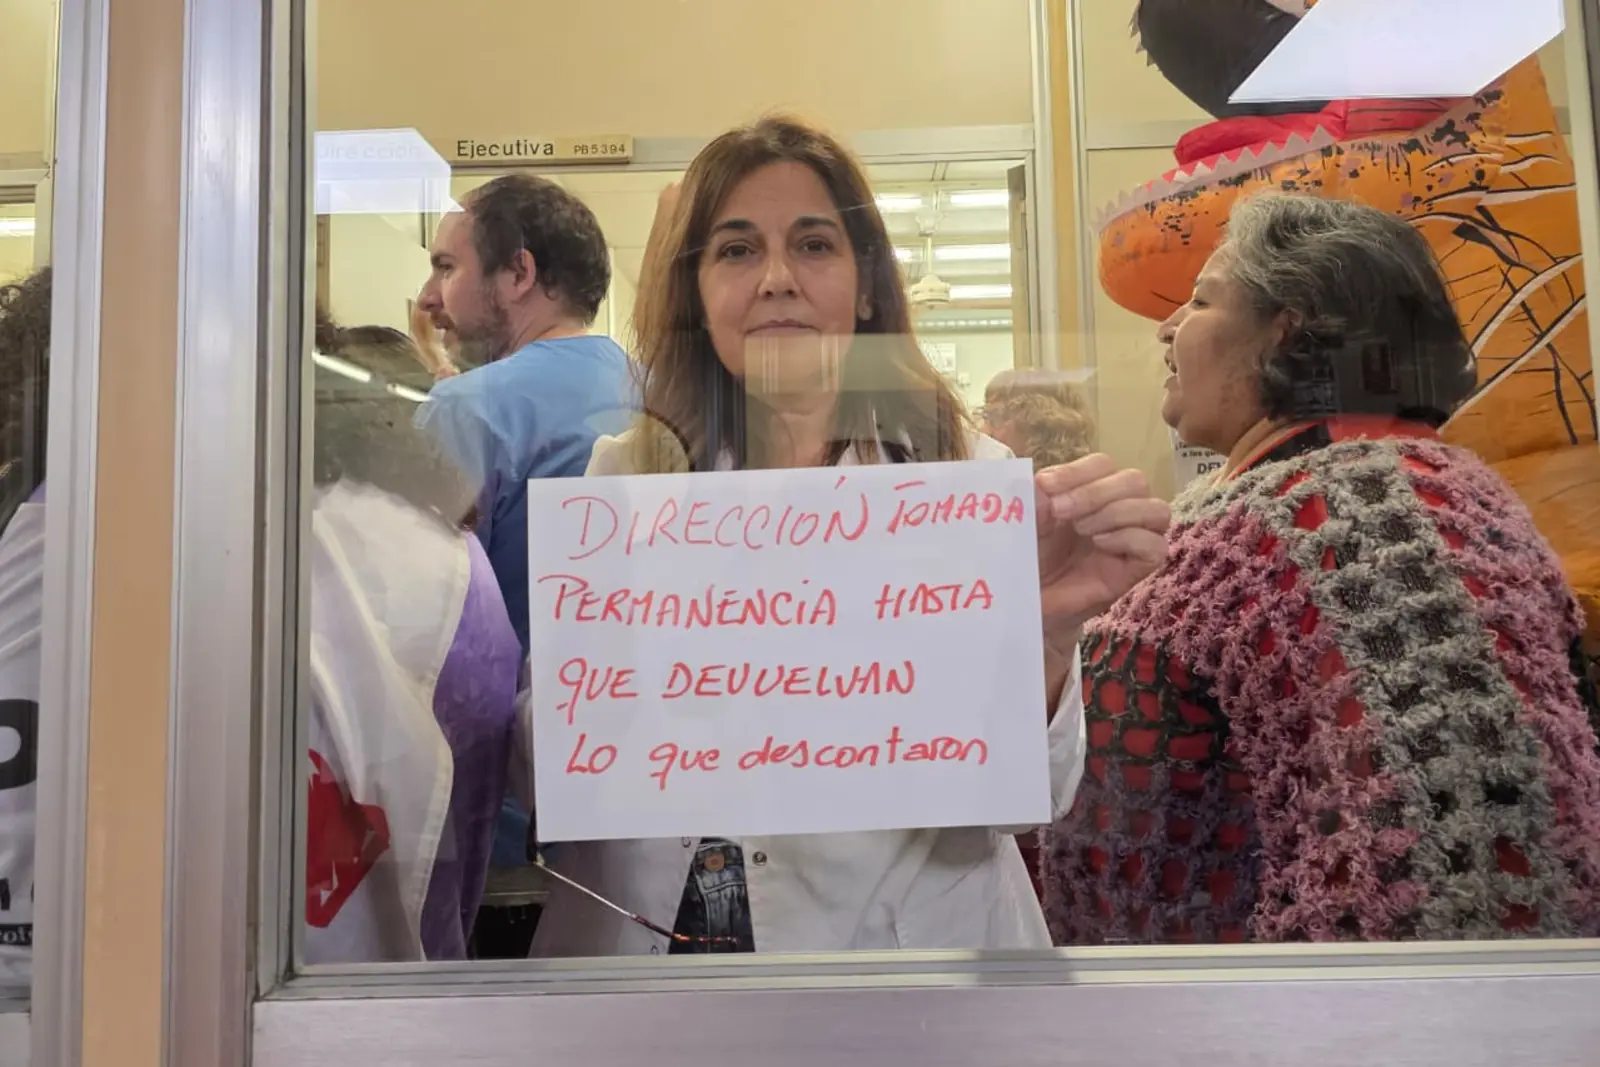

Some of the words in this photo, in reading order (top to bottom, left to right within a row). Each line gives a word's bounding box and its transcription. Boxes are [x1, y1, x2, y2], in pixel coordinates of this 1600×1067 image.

[457, 139, 554, 158] Ejecutiva
[574, 144, 626, 155] PB5394
[560, 475, 869, 560] DIRECCIÓN
[887, 480, 1025, 536] TOMADA
[875, 579, 994, 620] HASTA
[648, 742, 720, 790] que
[738, 725, 988, 771] descontaron
